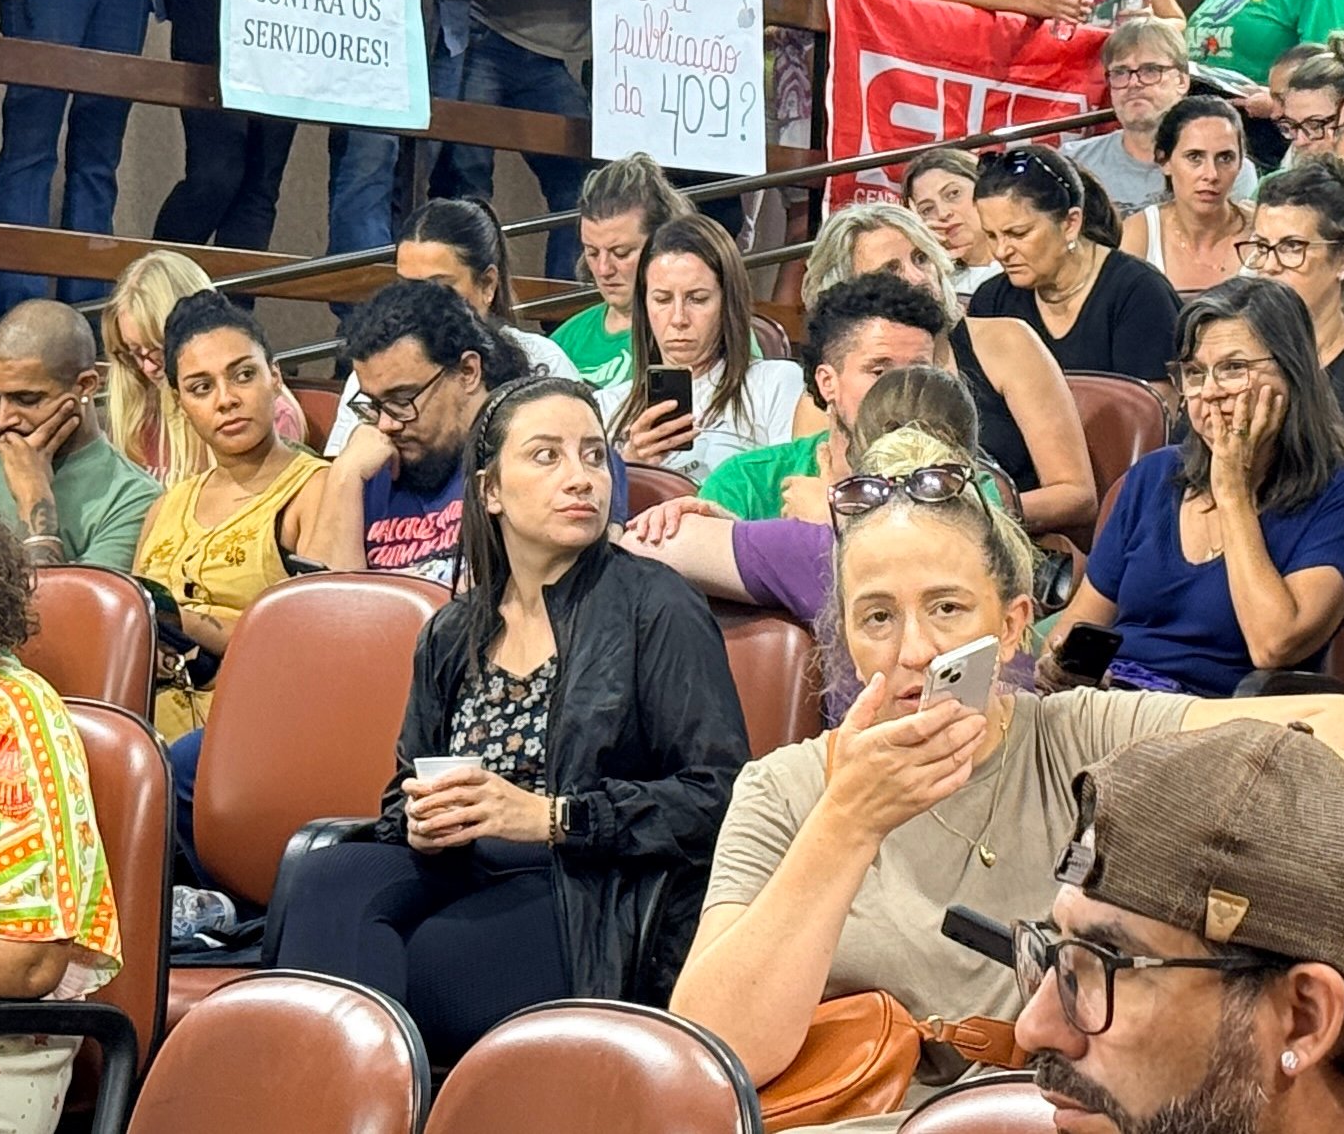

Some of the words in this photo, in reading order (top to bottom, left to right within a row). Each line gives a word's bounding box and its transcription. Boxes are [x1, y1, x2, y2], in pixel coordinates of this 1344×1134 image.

[242, 18, 390, 67] SERVIDORES!
[610, 3, 742, 78] publicação
[608, 66, 645, 118] da
[660, 73, 756, 156] 409?
